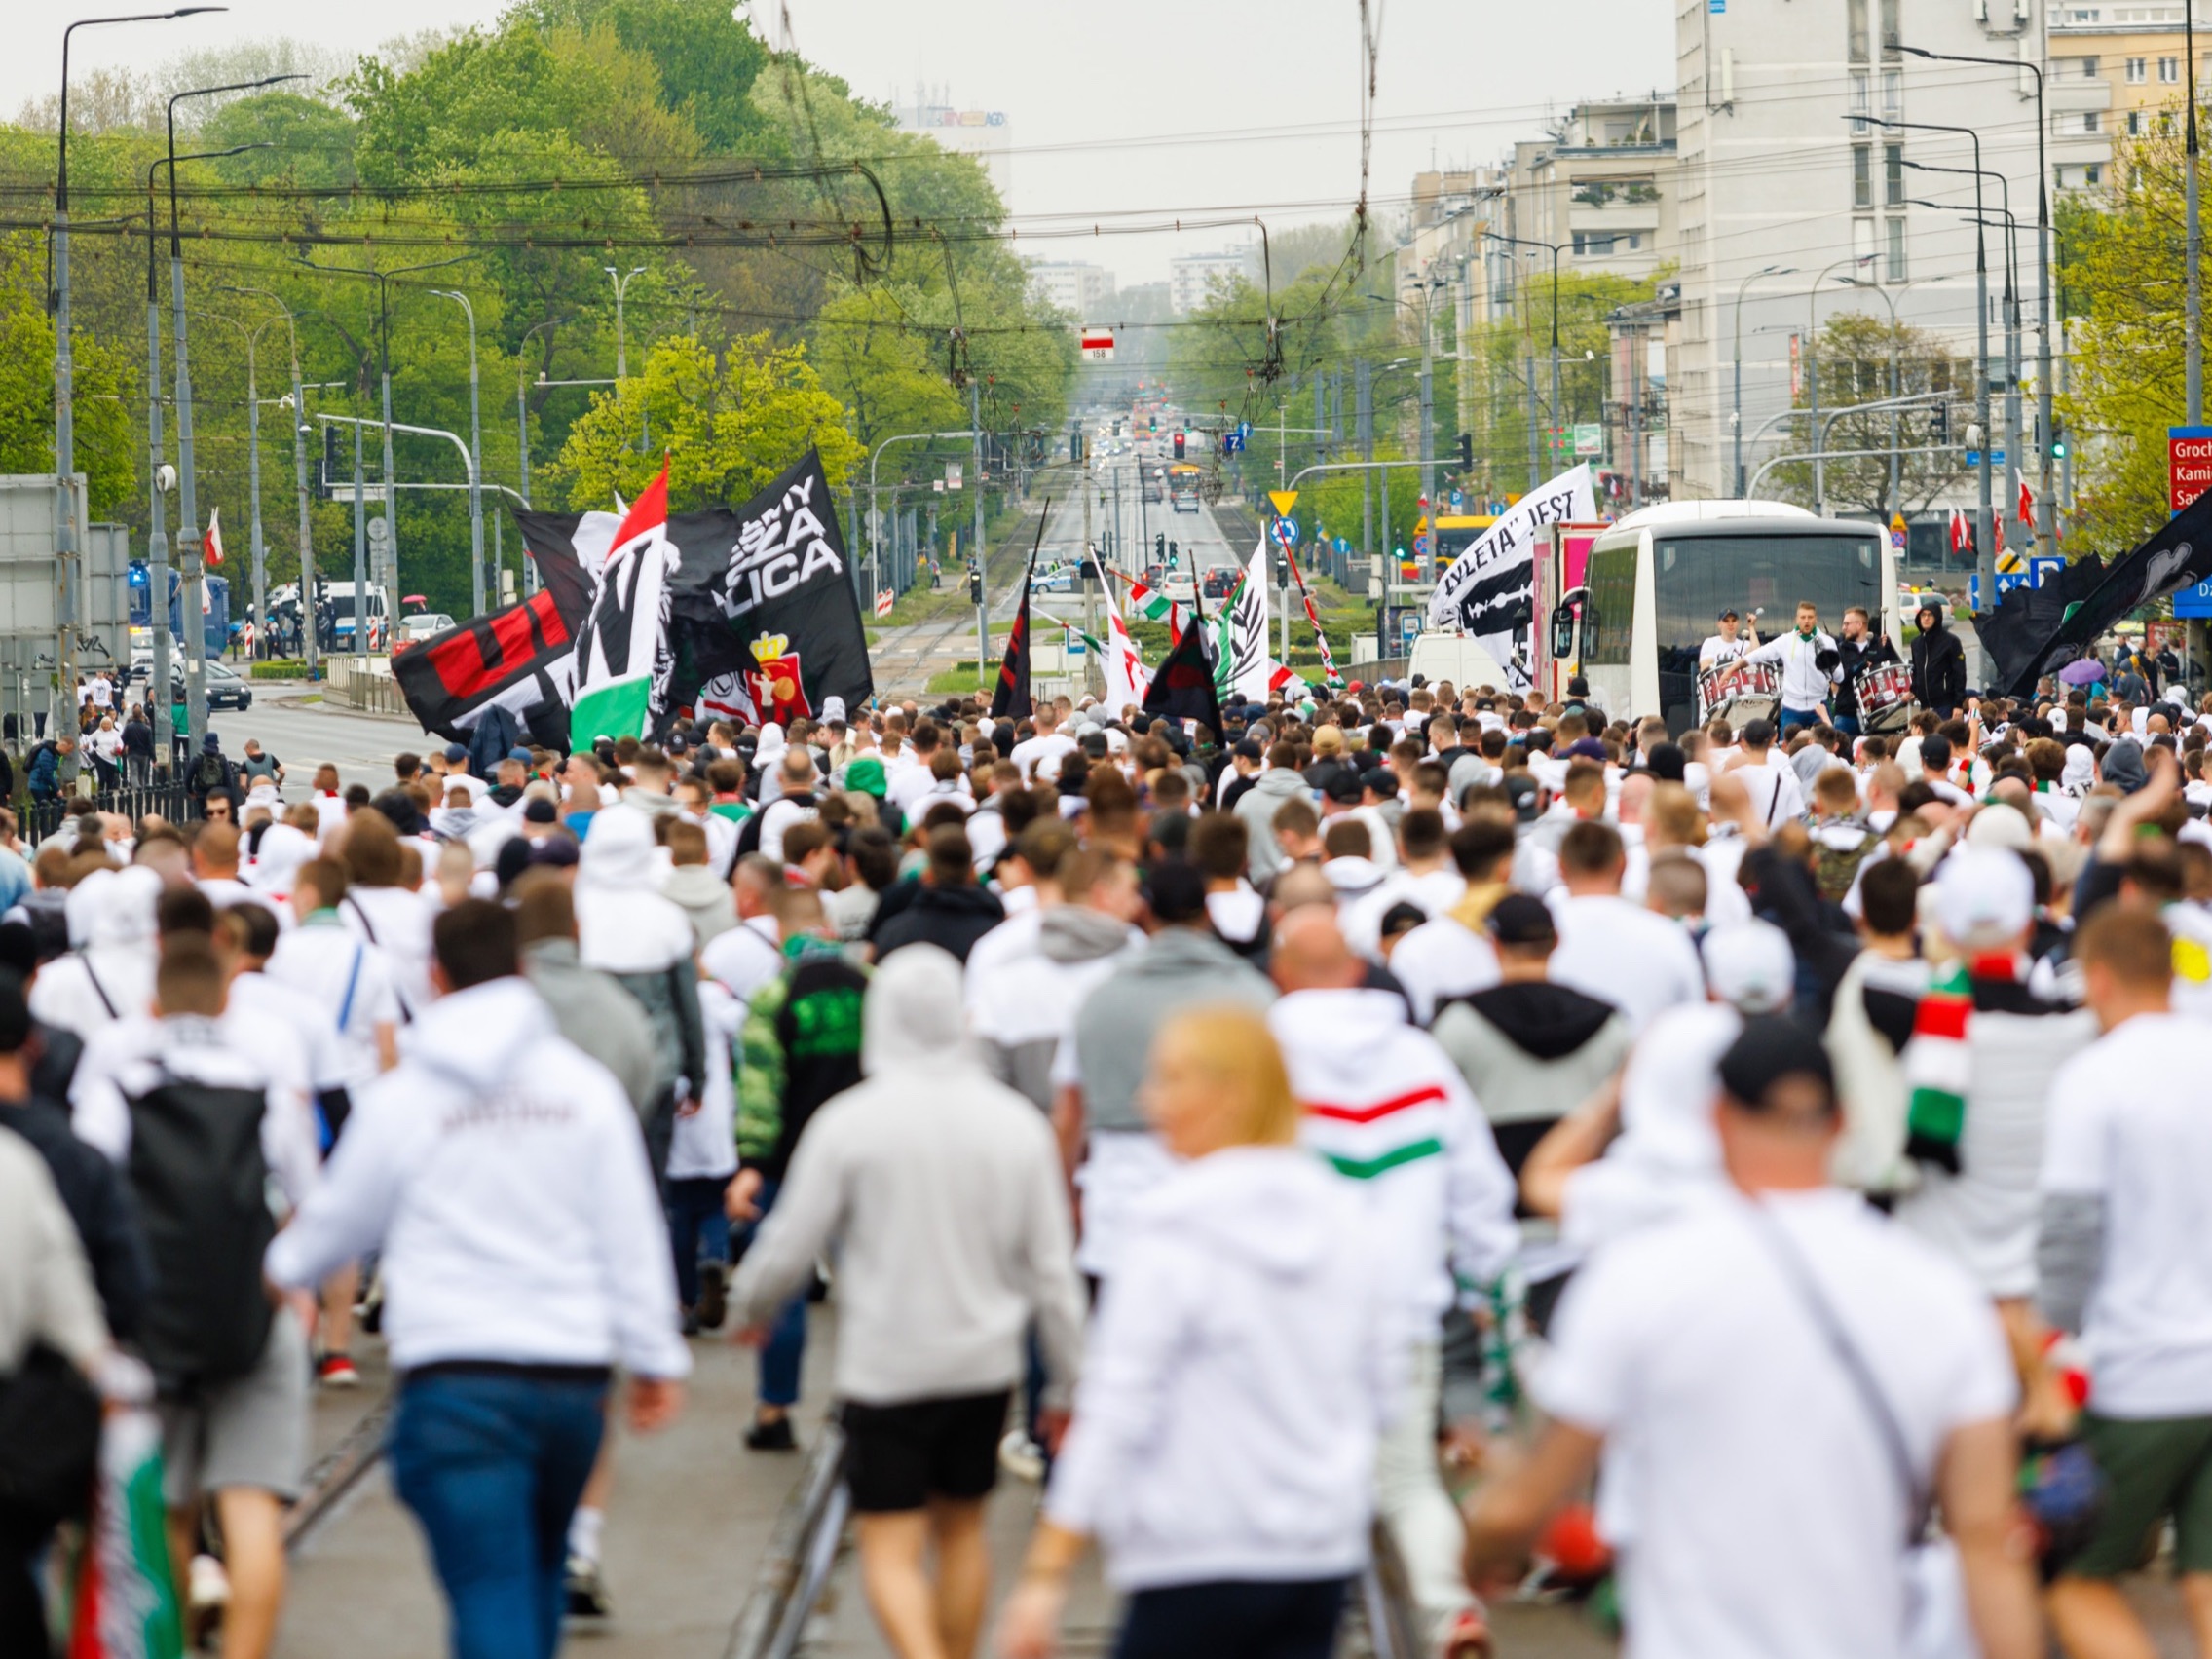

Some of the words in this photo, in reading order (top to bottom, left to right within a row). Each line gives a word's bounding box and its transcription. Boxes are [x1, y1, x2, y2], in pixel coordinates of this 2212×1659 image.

[1092, 350, 1106, 358] 158
[1230, 436, 1240, 449] 7
[2176, 465, 2212, 481] Kami
[1452, 493, 1461, 502] P
